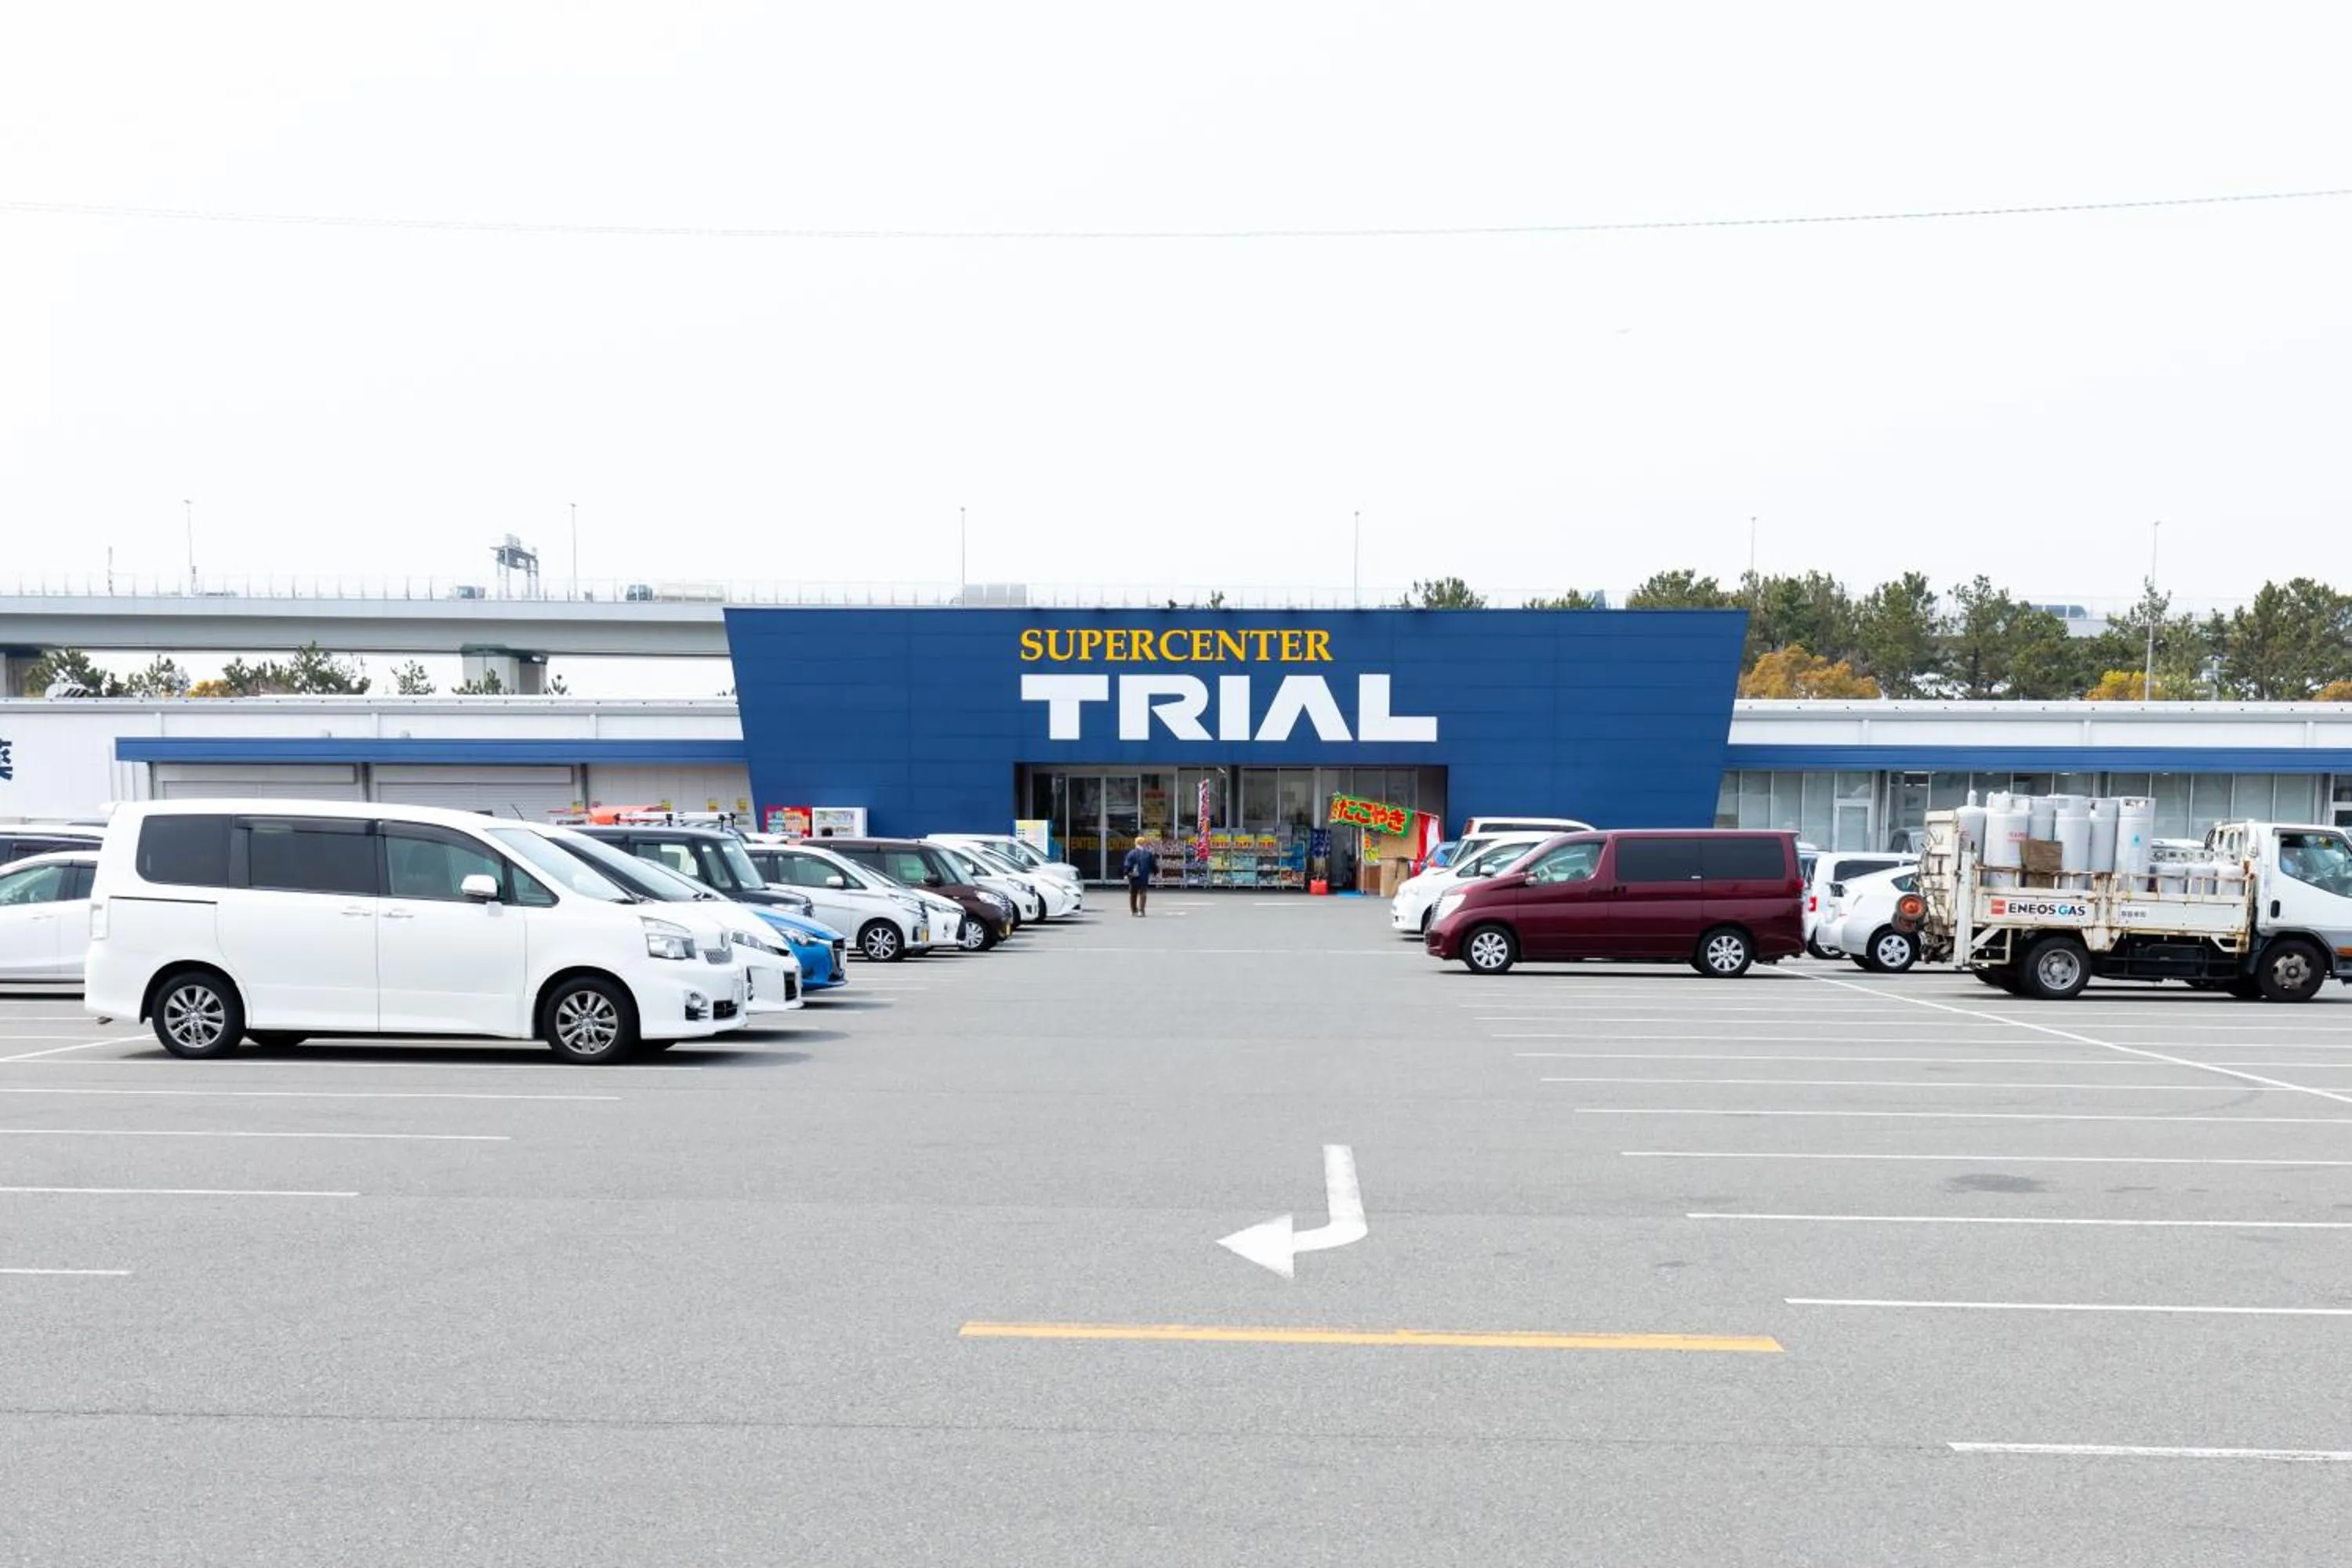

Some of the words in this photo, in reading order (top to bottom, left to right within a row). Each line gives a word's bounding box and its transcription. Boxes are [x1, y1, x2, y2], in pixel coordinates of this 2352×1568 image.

[1020, 629, 1333, 662] SUPERCENTER
[1021, 673, 1439, 742] TRIAL
[1338, 798, 1406, 833] たこやき
[2008, 902, 2056, 915] ENEOS
[2057, 904, 2086, 916] GAS
